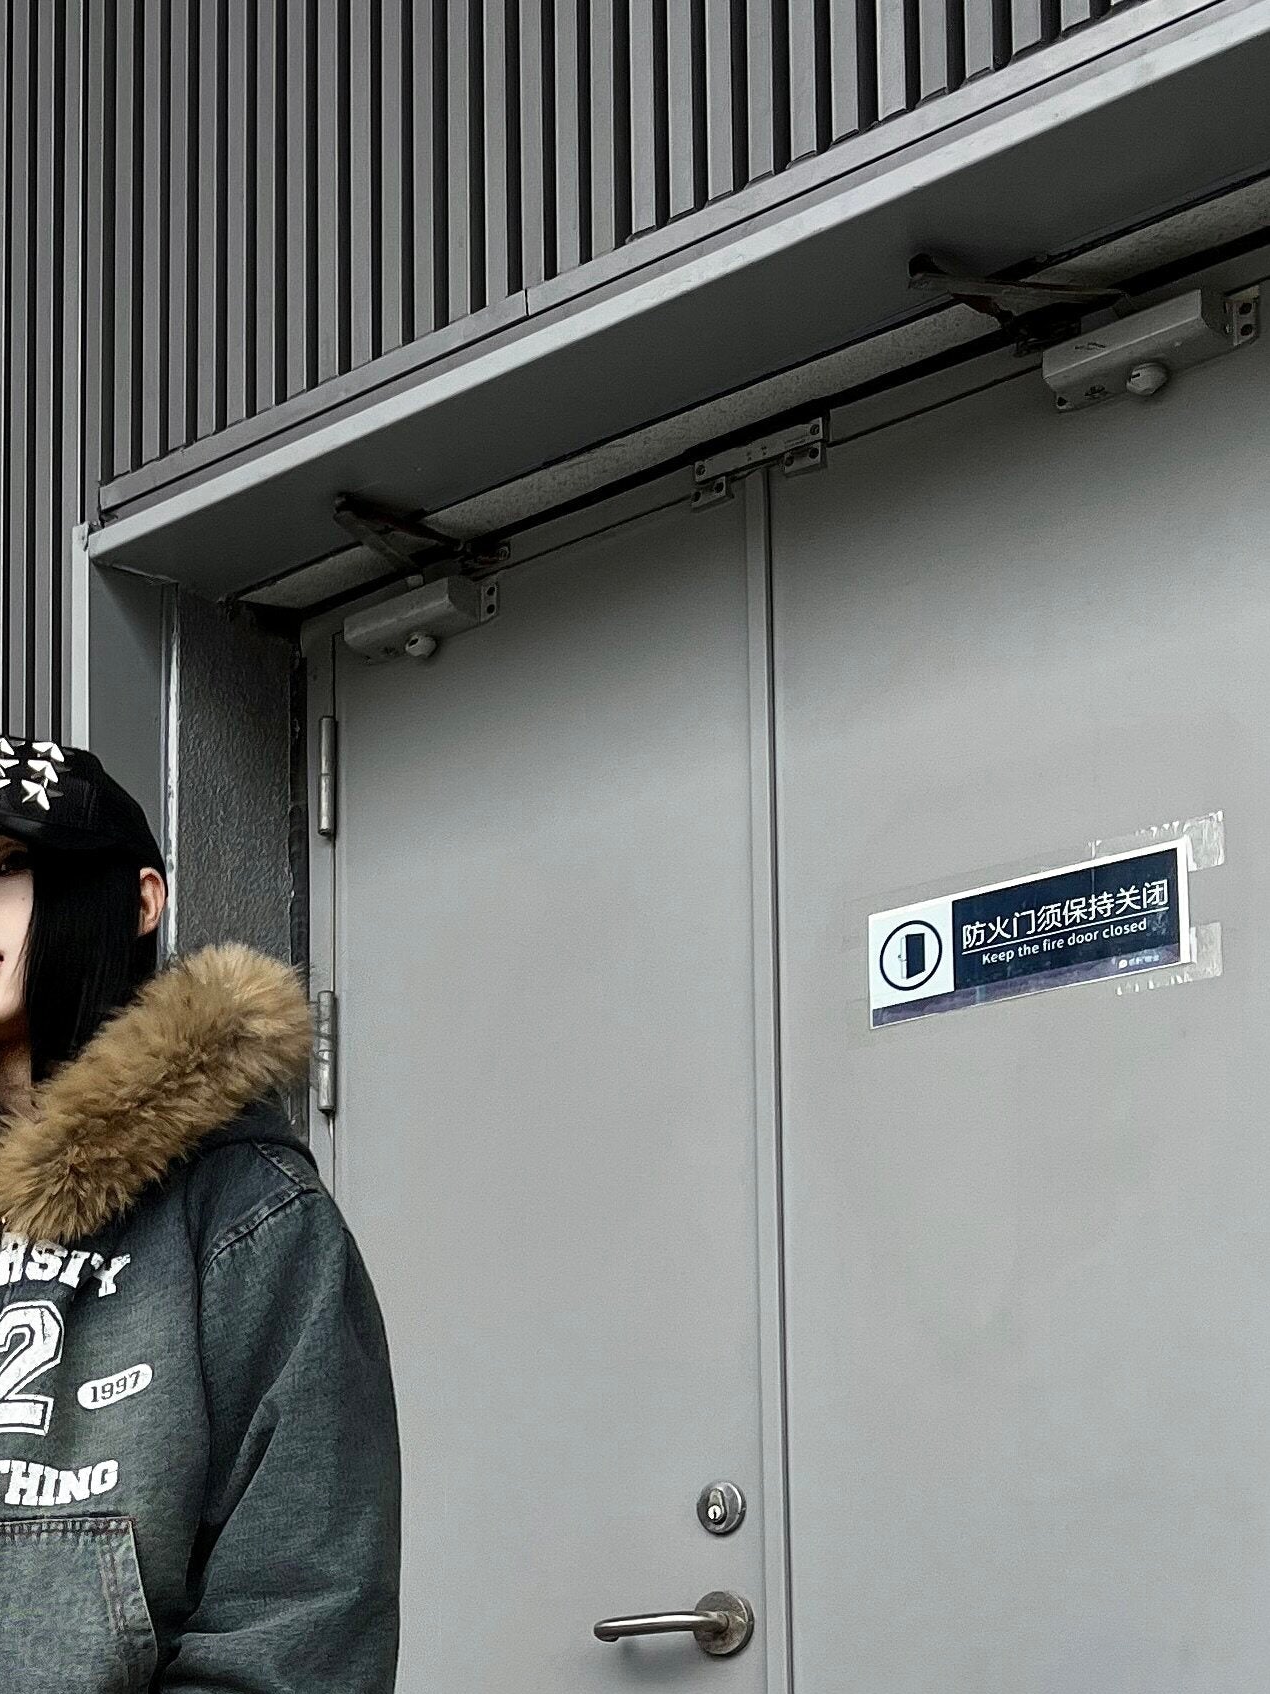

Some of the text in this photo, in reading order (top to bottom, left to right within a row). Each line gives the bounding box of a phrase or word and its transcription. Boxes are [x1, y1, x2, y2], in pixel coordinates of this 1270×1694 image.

[962, 879, 1169, 950] 防火门须保持关闭
[982, 917, 1147, 966] Keep the fire door closed
[90, 1369, 141, 1403] 1997
